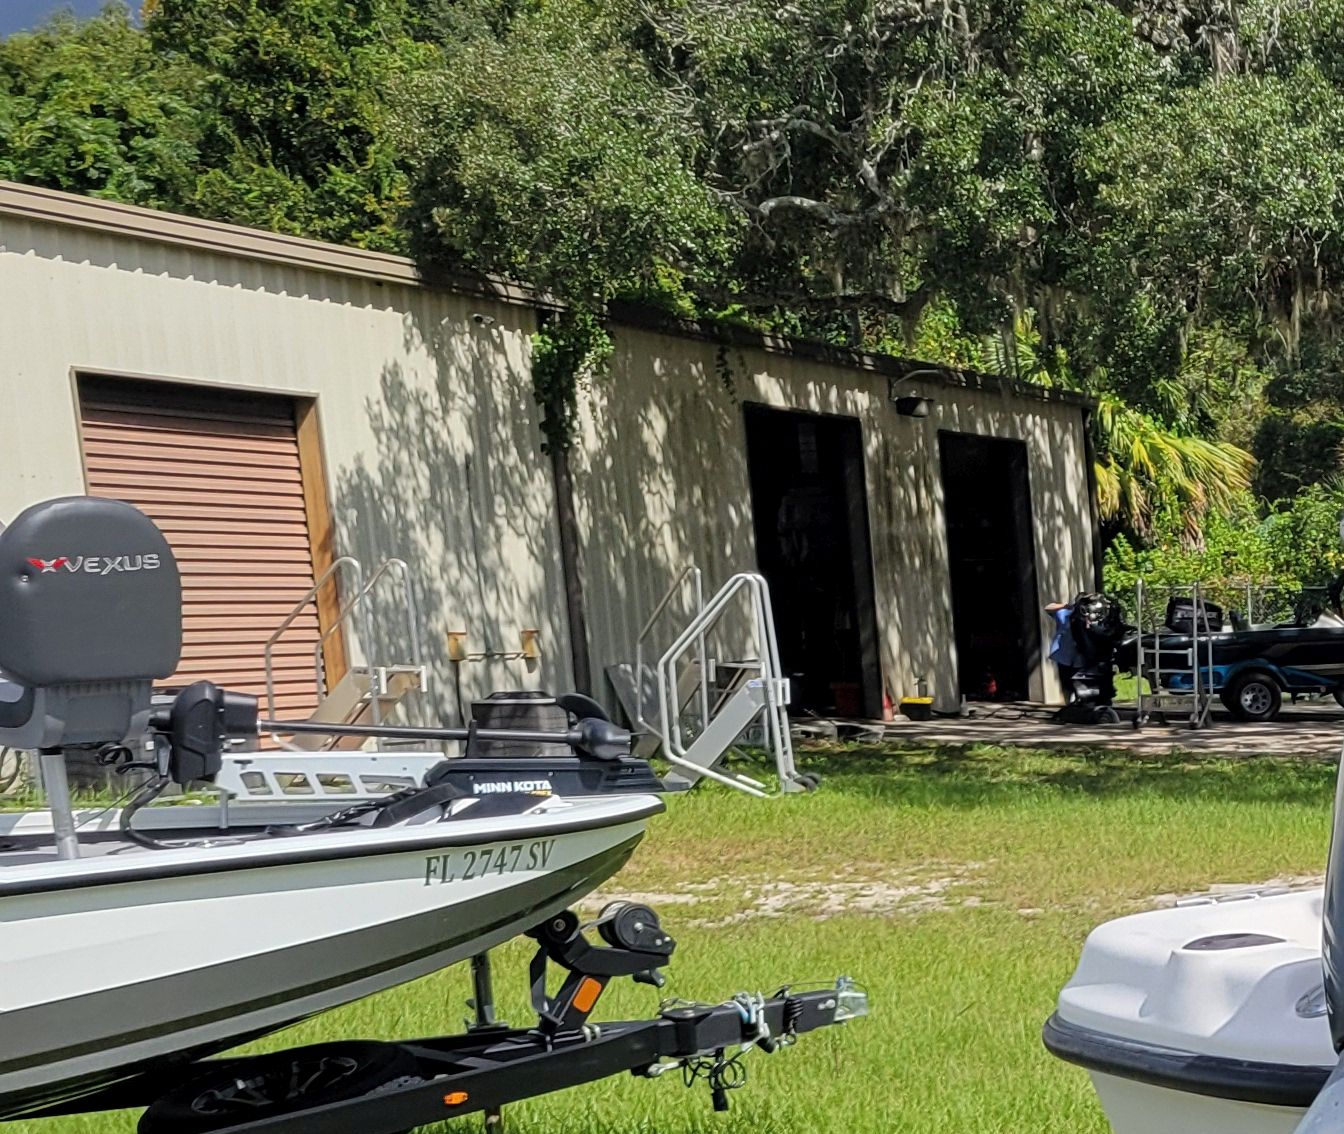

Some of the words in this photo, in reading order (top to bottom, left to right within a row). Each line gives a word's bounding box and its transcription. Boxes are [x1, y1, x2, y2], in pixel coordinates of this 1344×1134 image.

[64, 553, 161, 576] VEXUS
[473, 782, 512, 795] MINN
[513, 780, 553, 793] KOTA
[424, 854, 455, 887] FL
[462, 844, 525, 881] 2747
[526, 839, 556, 871] SV
